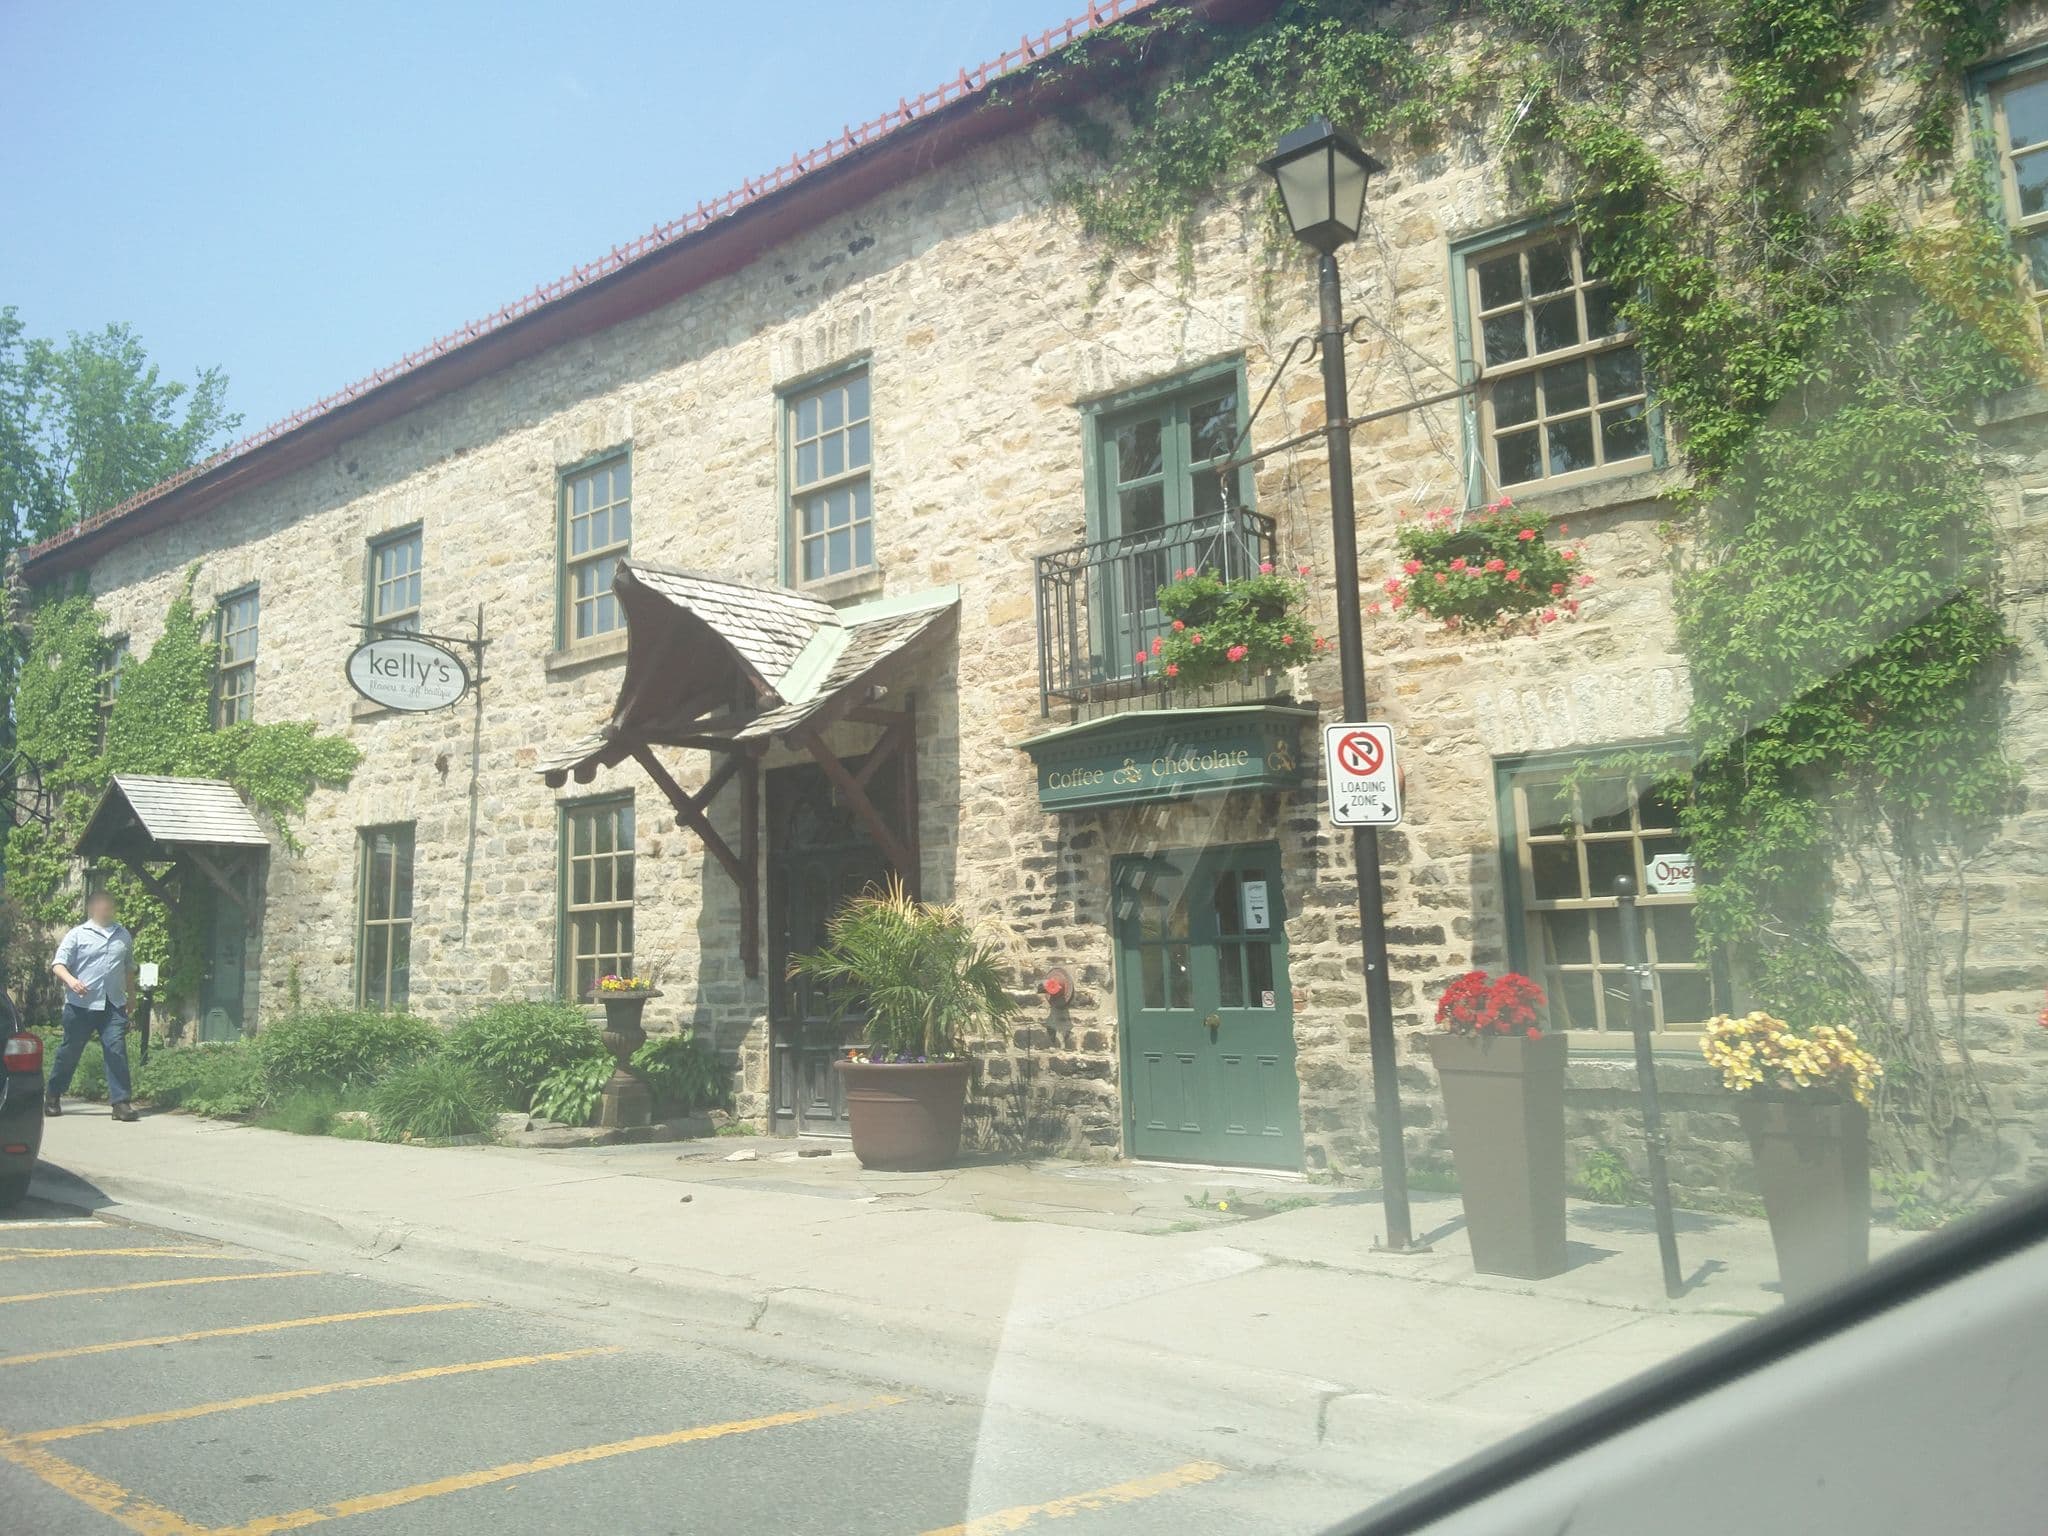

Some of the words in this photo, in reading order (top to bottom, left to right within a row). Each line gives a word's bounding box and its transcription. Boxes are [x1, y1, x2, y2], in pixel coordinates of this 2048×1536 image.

[369, 648, 450, 687] kelly's
[1048, 767, 1104, 790] Coffee
[1151, 747, 1249, 777] Chocolate
[1341, 781, 1386, 793] LOADING
[1351, 795, 1379, 807] ZONE
